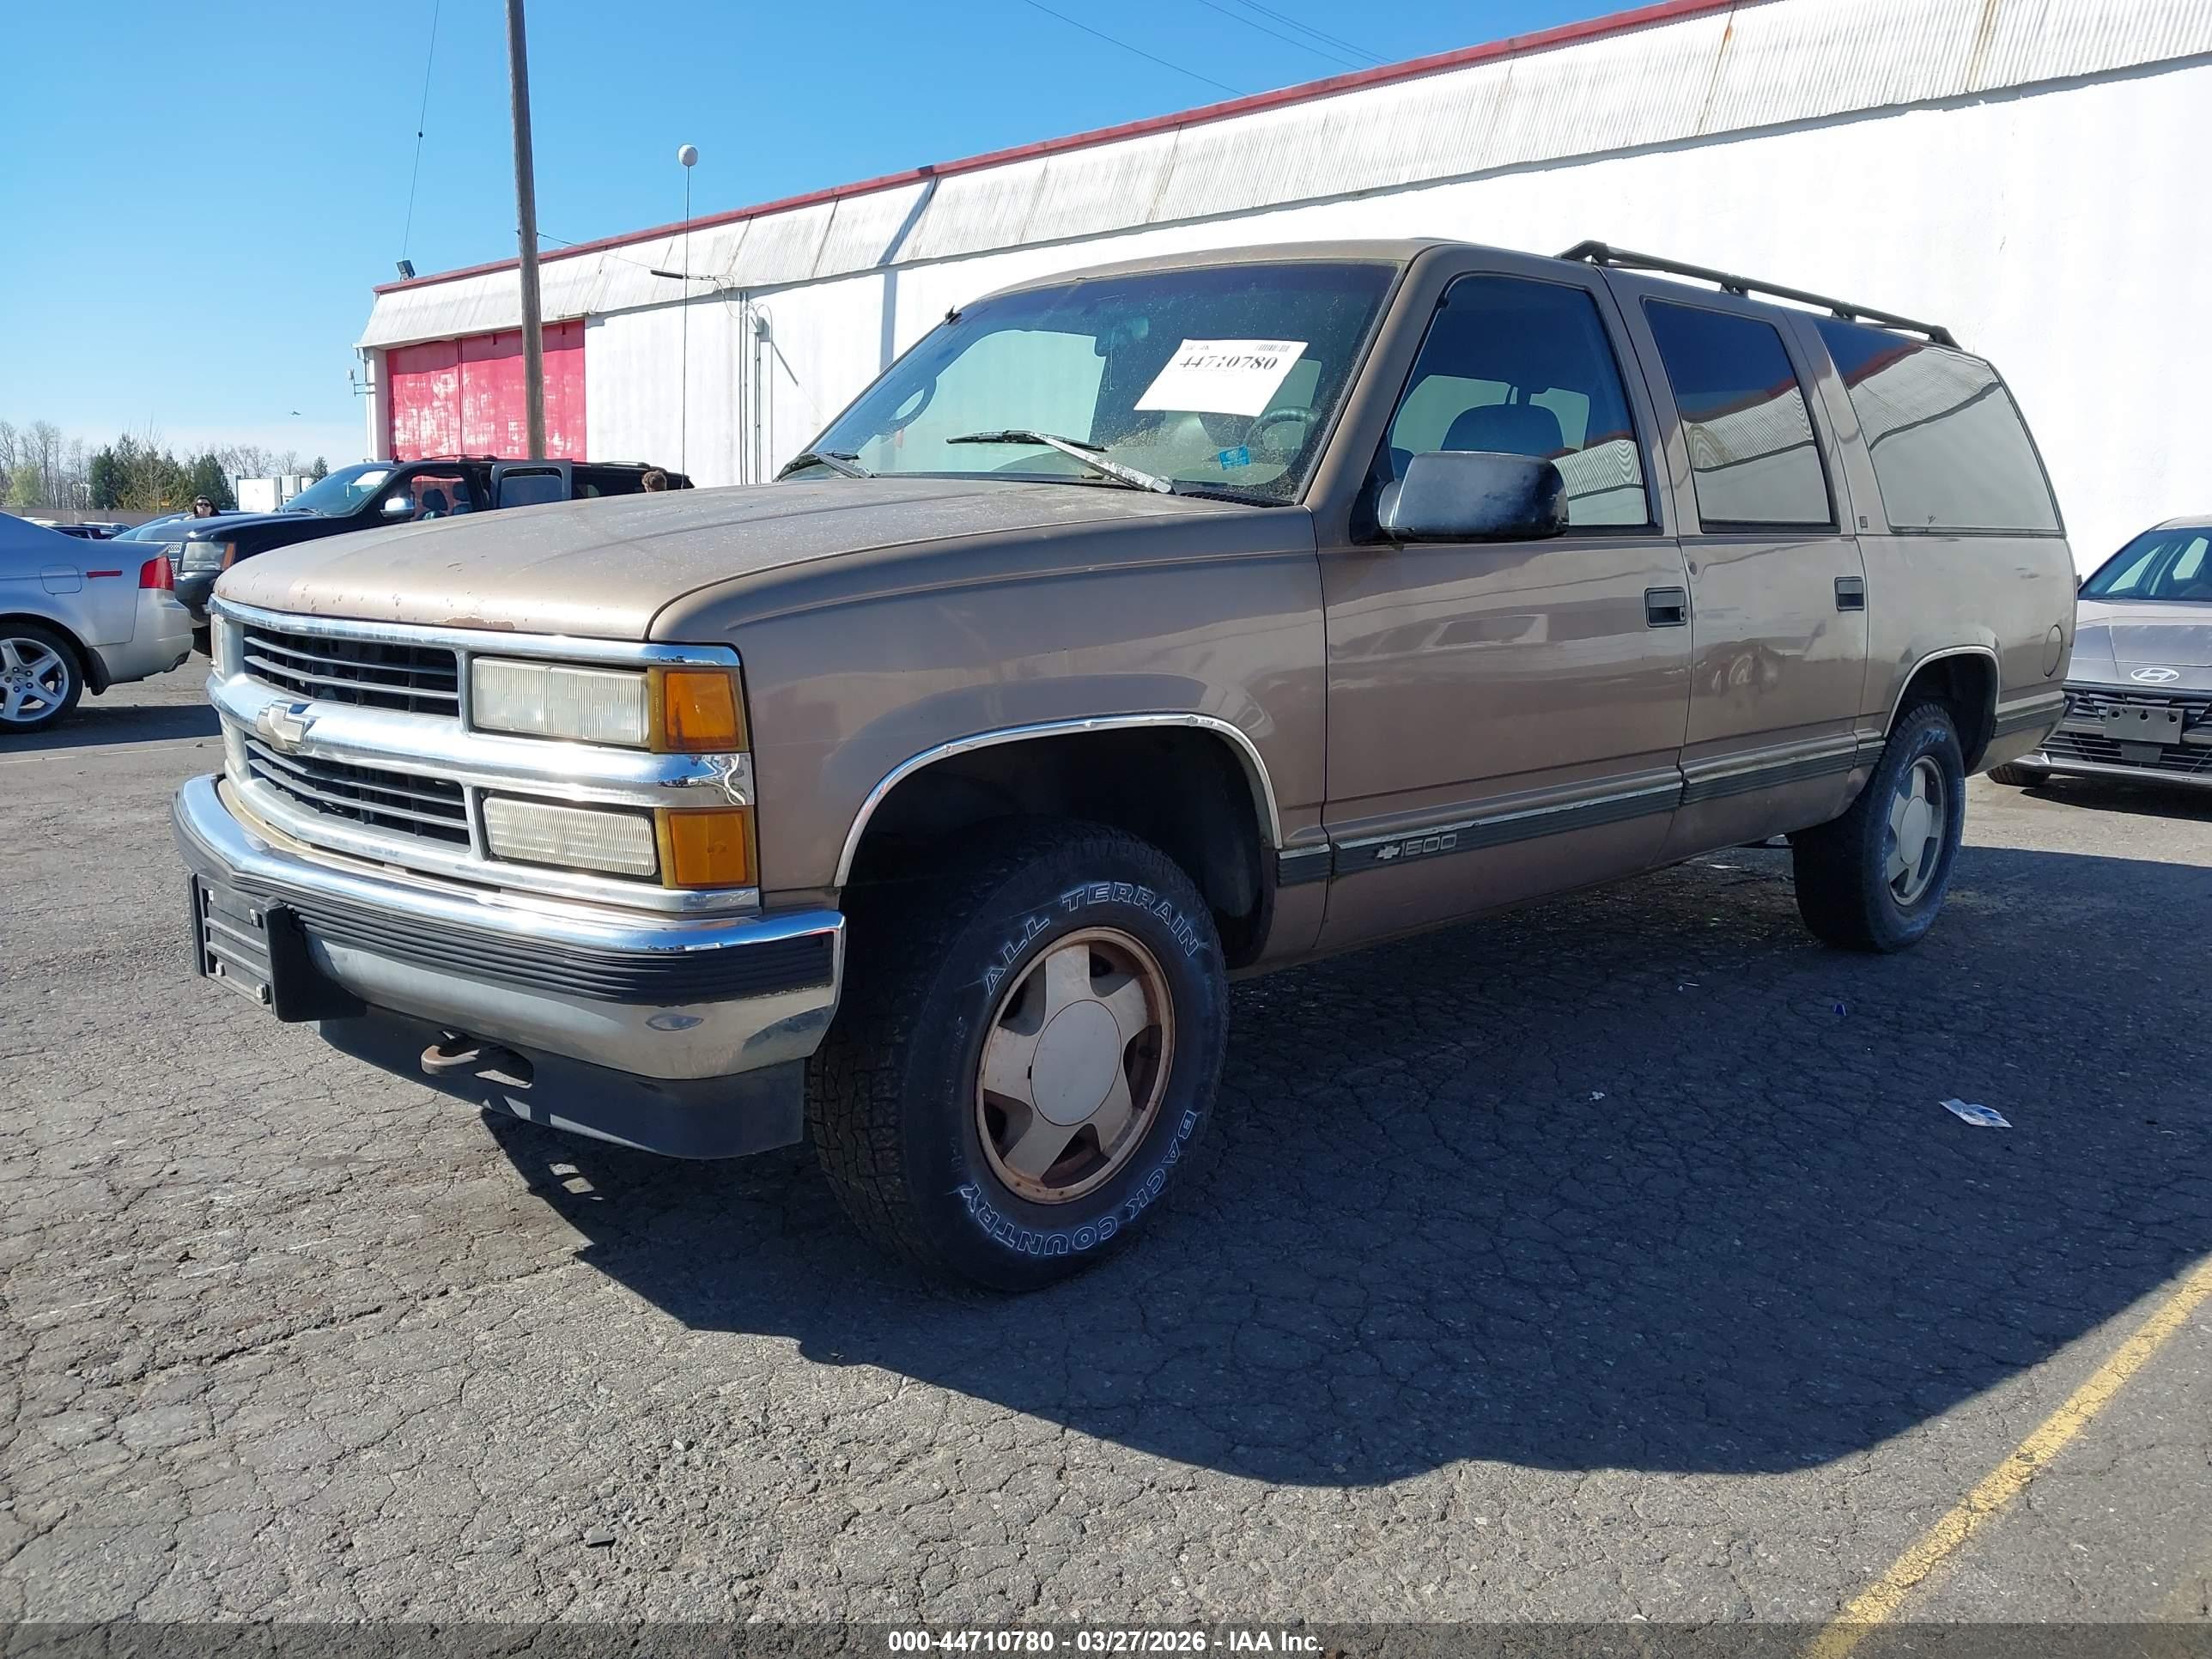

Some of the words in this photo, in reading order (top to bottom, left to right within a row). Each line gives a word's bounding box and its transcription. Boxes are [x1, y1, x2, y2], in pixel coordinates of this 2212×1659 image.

[985, 916, 1051, 996] ALL
[1060, 881, 1200, 957] TERRAIN
[959, 1183, 1118, 1256] COUNTRY
[1125, 1109, 1197, 1220] BACK
